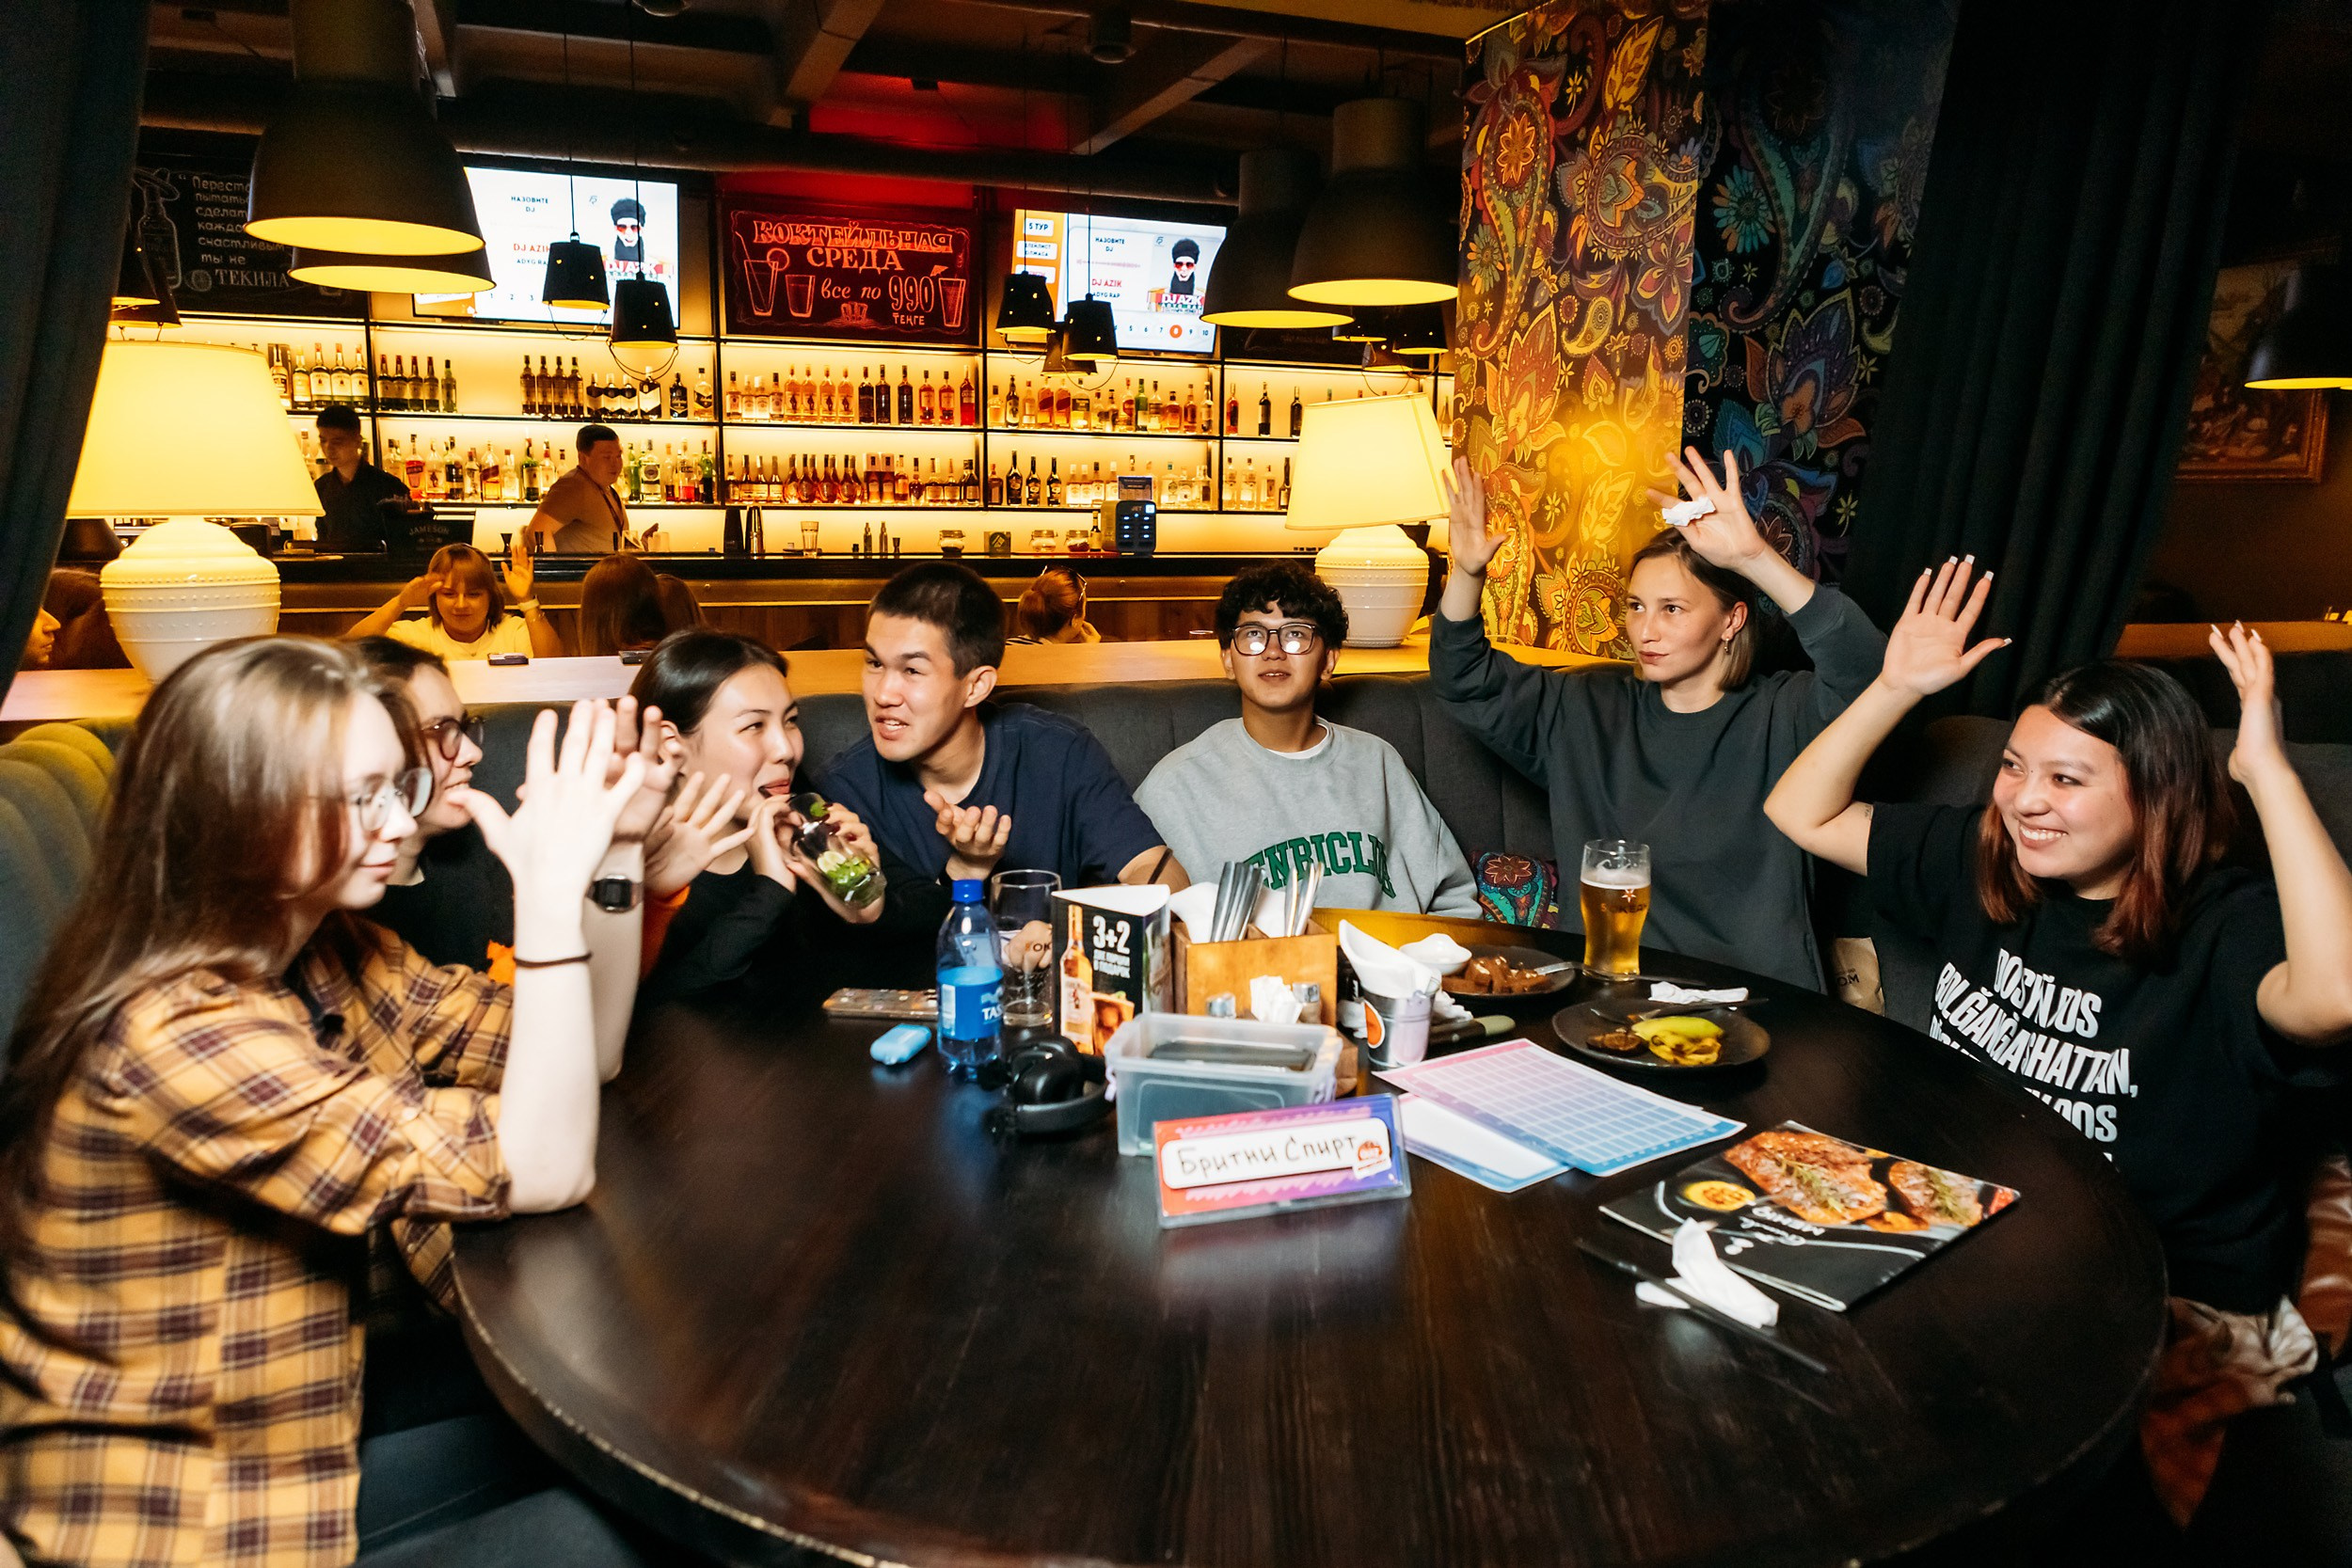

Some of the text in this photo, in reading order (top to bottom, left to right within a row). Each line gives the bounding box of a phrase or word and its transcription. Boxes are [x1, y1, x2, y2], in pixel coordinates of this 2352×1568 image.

[511, 196, 548, 204] НАЗОВИТЕ
[1035, 223, 1049, 231] ТУР
[753, 220, 954, 253] КОКТЕЙЛЬНАЯ
[1094, 236, 1125, 245] НАЗОВИТЕ
[513, 243, 527, 252] DJ
[806, 246, 905, 275] СРЕДА
[215, 268, 291, 288] ТЕКИЛА
[1104, 279, 1122, 288] AZIK
[820, 275, 935, 313] все по 990
[408, 525, 450, 536] JAMESON
[1092, 914, 1131, 955] 3+2
[1176, 1134, 1358, 1179] Бритни Спирт
